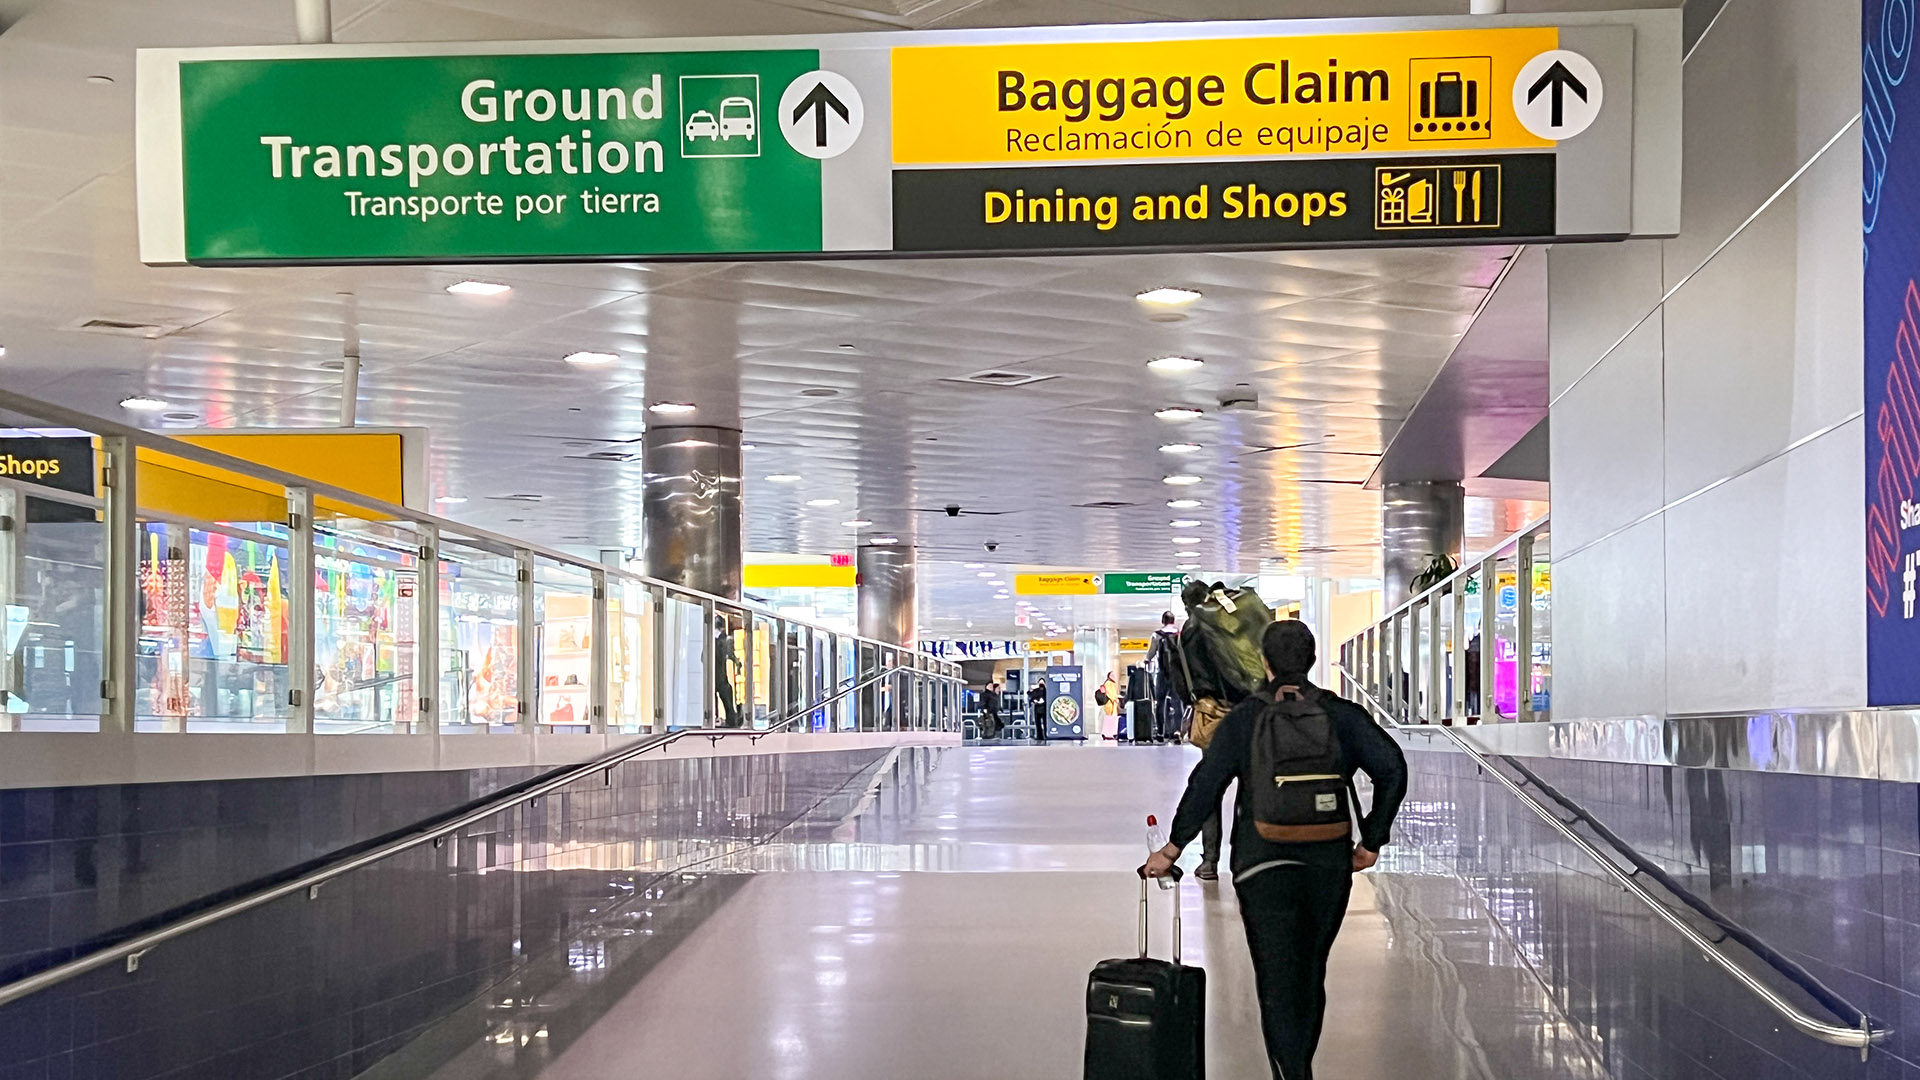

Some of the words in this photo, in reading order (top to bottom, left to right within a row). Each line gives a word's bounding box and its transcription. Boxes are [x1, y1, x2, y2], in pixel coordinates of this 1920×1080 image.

[461, 73, 663, 123] Ground
[998, 70, 1225, 123] Baggage
[1244, 58, 1389, 105] Claim
[260, 130, 664, 188] Transportation
[1006, 123, 1192, 154] Reclamación
[1206, 120, 1243, 147] de
[1257, 117, 1389, 152] equipaje
[343, 191, 504, 222] Transporte
[515, 193, 568, 222] por
[580, 189, 660, 215] tierra
[983, 188, 1118, 231] Dining
[1132, 184, 1208, 222] and
[1221, 183, 1347, 227] Shops
[0, 454, 61, 480] Shops
